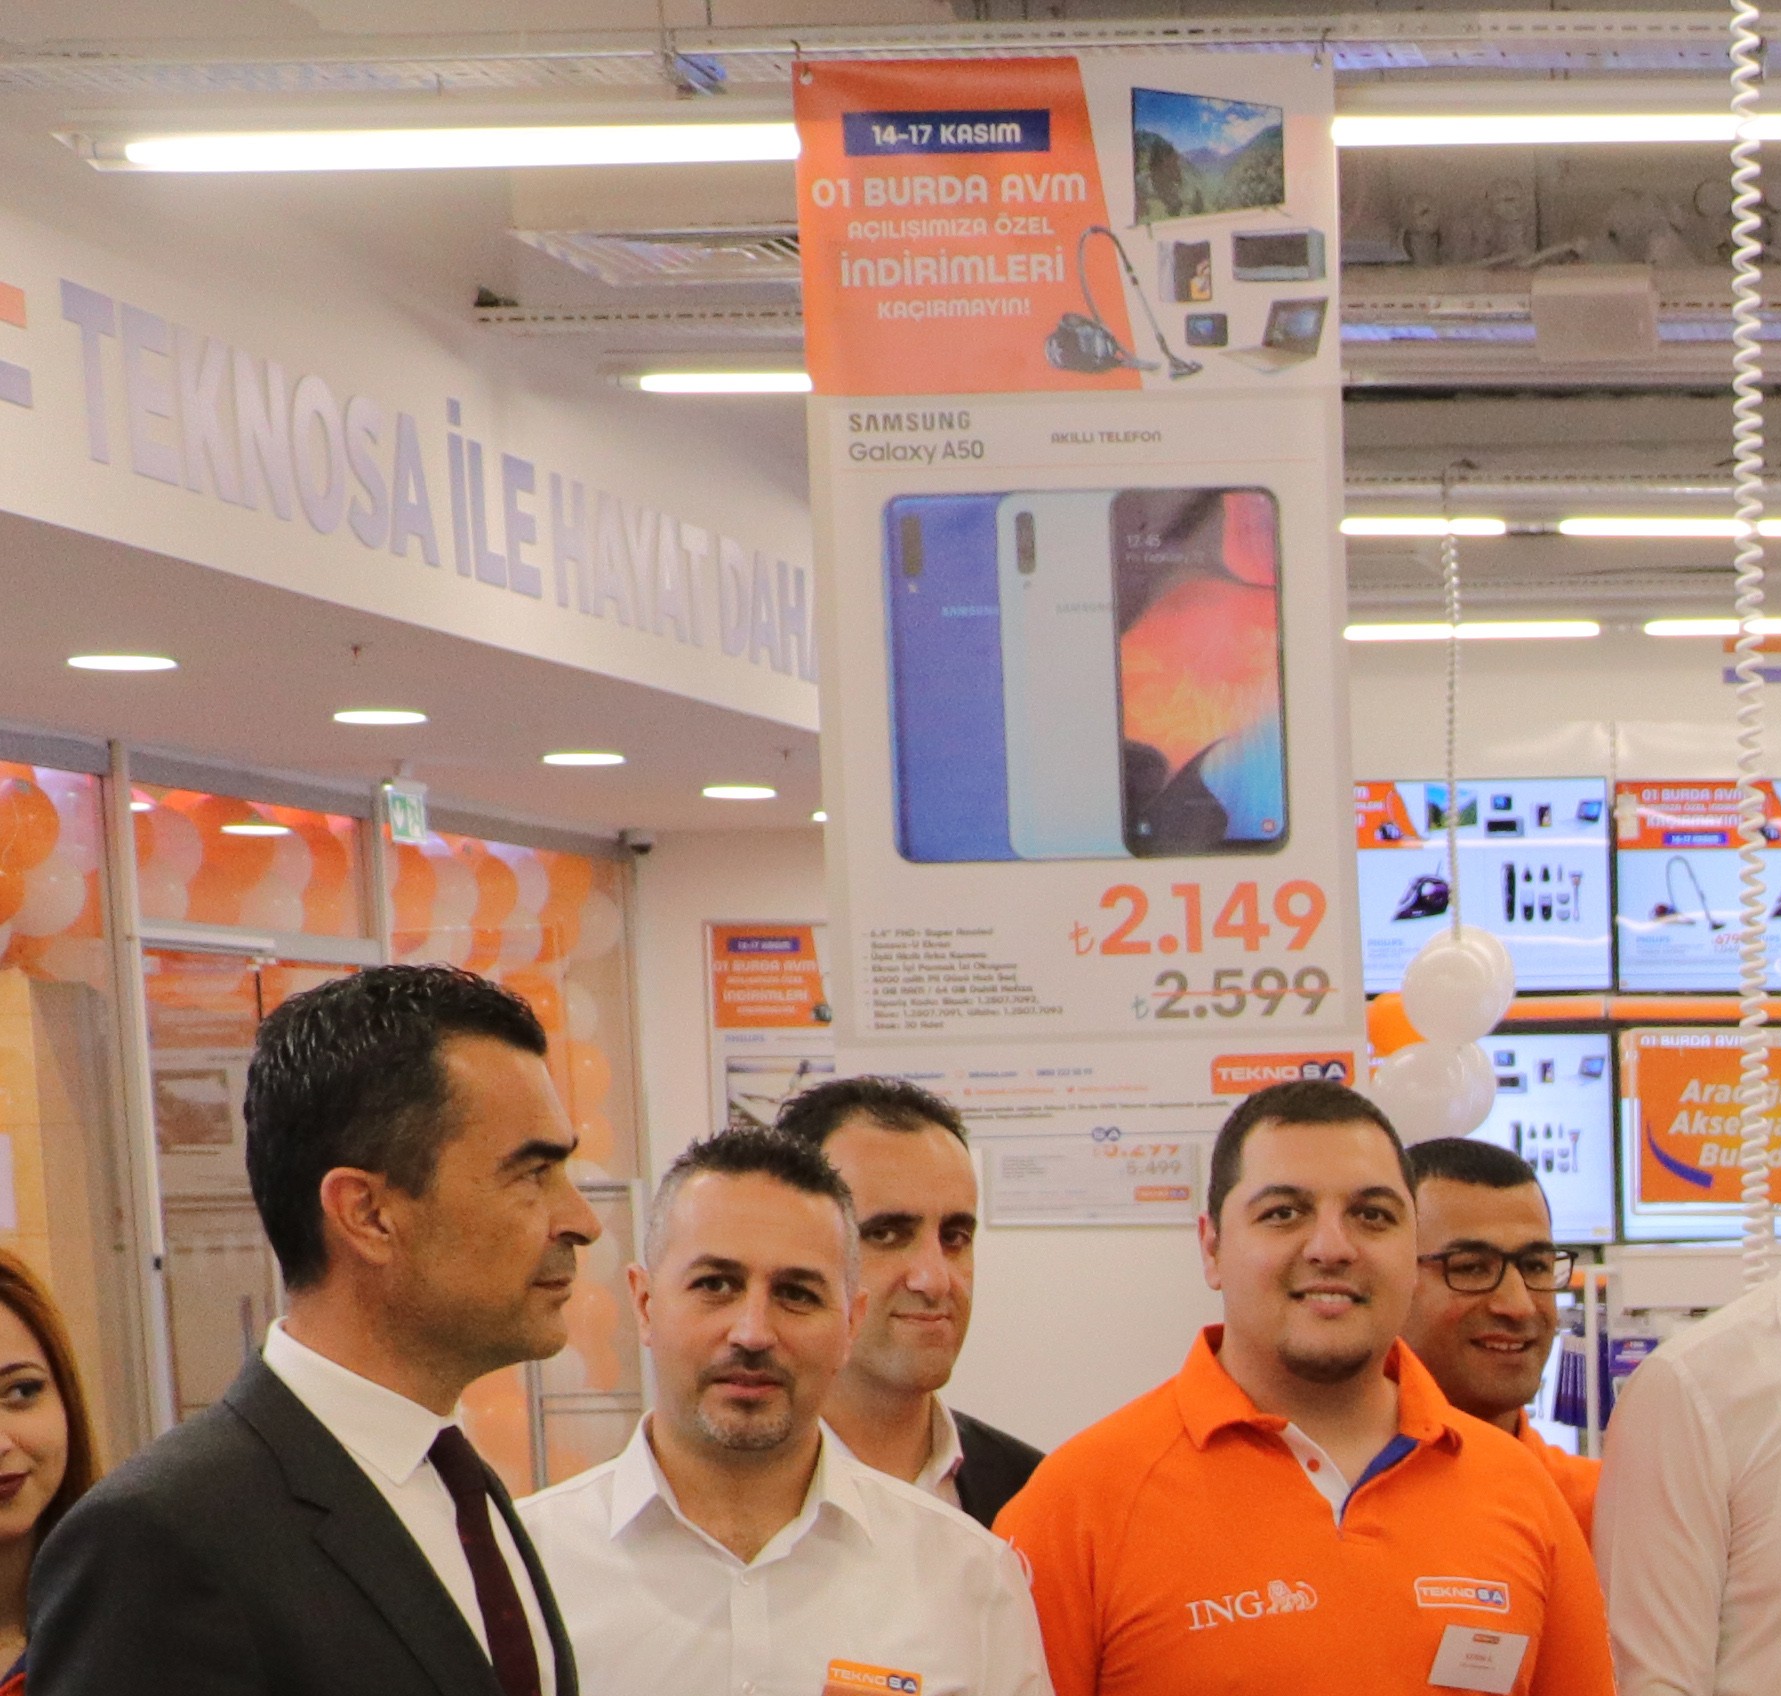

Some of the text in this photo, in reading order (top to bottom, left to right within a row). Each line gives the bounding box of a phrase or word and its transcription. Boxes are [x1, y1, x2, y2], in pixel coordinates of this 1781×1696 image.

[871, 122, 1022, 146] 14-17 KASIM
[812, 172, 1087, 207] 01 BURDA AVM
[847, 212, 1055, 243] AÇILIŞIMIZA ÖZEL
[840, 246, 1066, 288] İNDİRİMLERİ
[877, 297, 1031, 321] KAÇIRMAYIN!
[848, 411, 971, 433] SAMSUNG
[1051, 430, 1162, 444] AKILLI TELEFON
[849, 440, 984, 466] Galaxy A50
[60, 278, 818, 684] TEKNOSA İLE HAYAT DAH
[1661, 789, 1711, 801] BURDA
[1661, 1035, 1711, 1047] BURDA
[1215, 1060, 1349, 1084] TEKNOSA
[1419, 1585, 1505, 1605] TEKNOSA
[1186, 1587, 1264, 1632] ING
[829, 1666, 918, 1694] TEKNOSA
